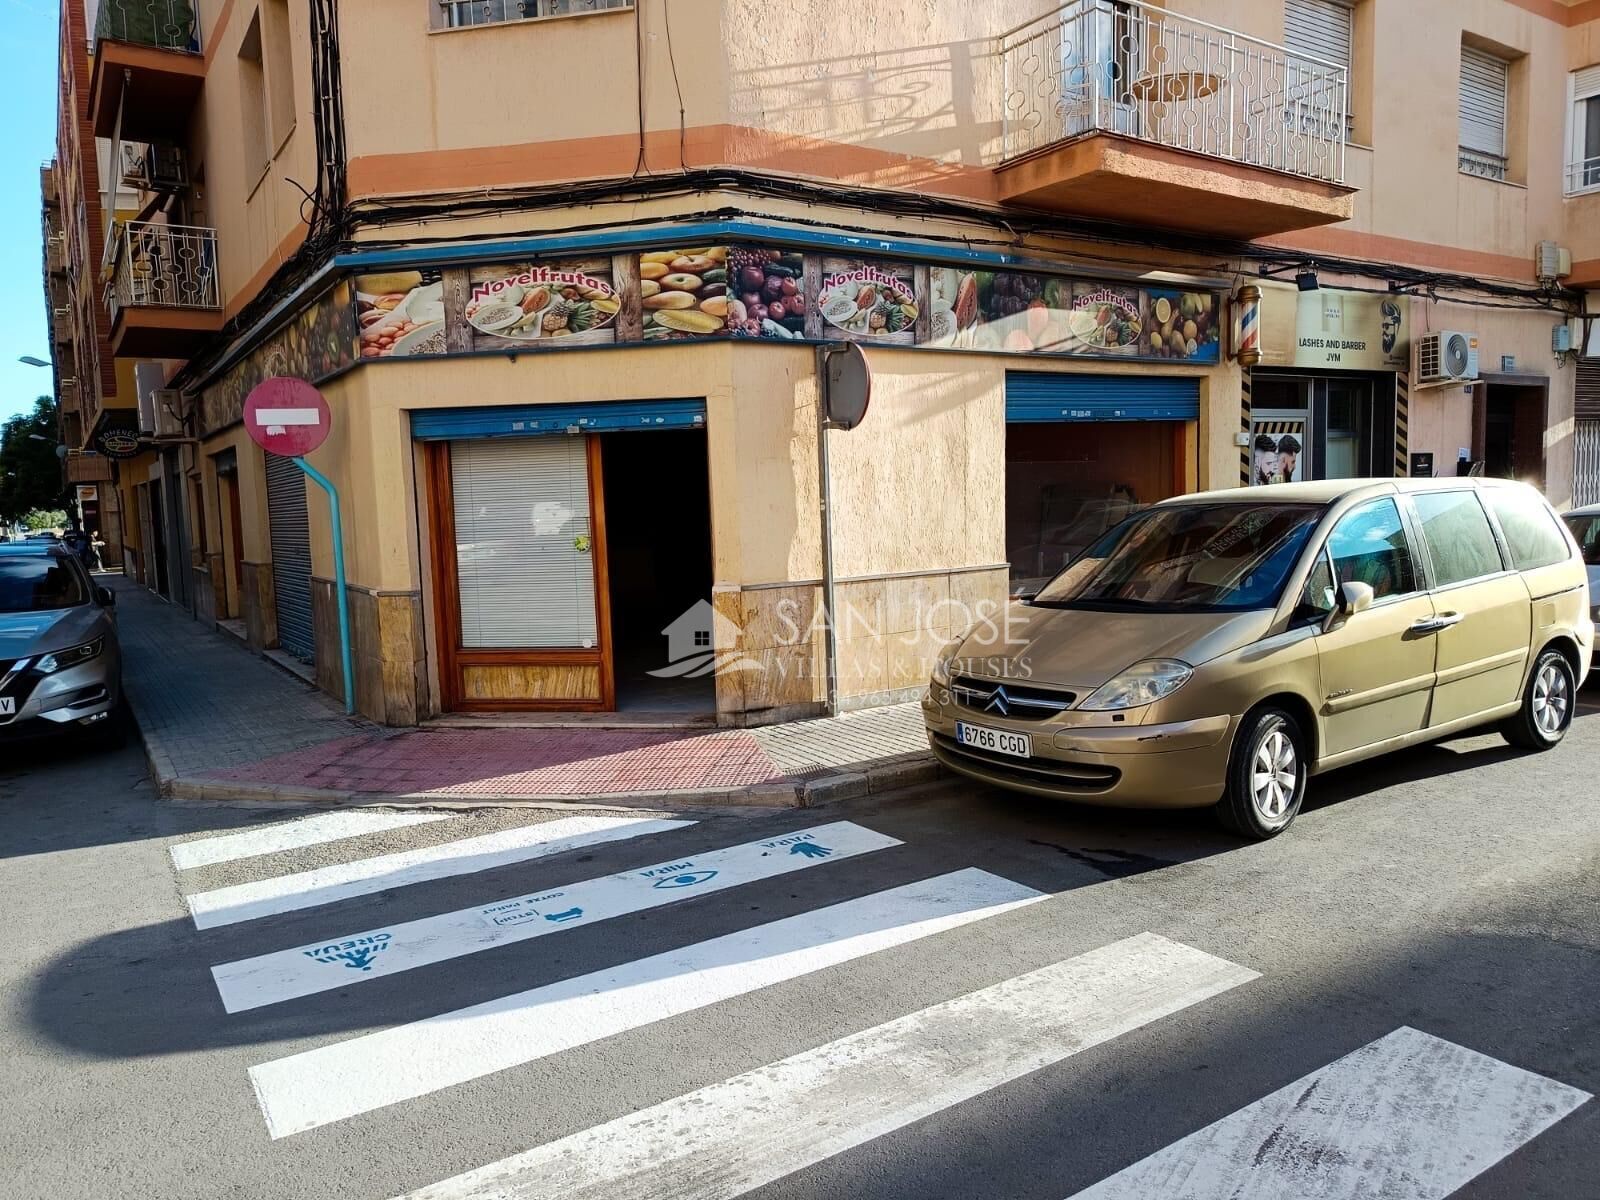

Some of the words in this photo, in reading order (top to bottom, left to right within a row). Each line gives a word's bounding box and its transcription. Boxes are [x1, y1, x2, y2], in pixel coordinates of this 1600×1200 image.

[472, 267, 612, 303] Novelfrutas
[824, 265, 913, 300] Novelfrutas
[1299, 337, 1324, 349] LASHES
[1325, 339, 1340, 350] AND
[1341, 340, 1367, 351] BARBER
[1326, 353, 1341, 363] JYM
[964, 726, 995, 748] 6766
[999, 734, 1026, 754] CGD
[760, 833, 816, 849] PARA
[639, 861, 694, 878] MIRA
[303, 933, 392, 957] CREUA
